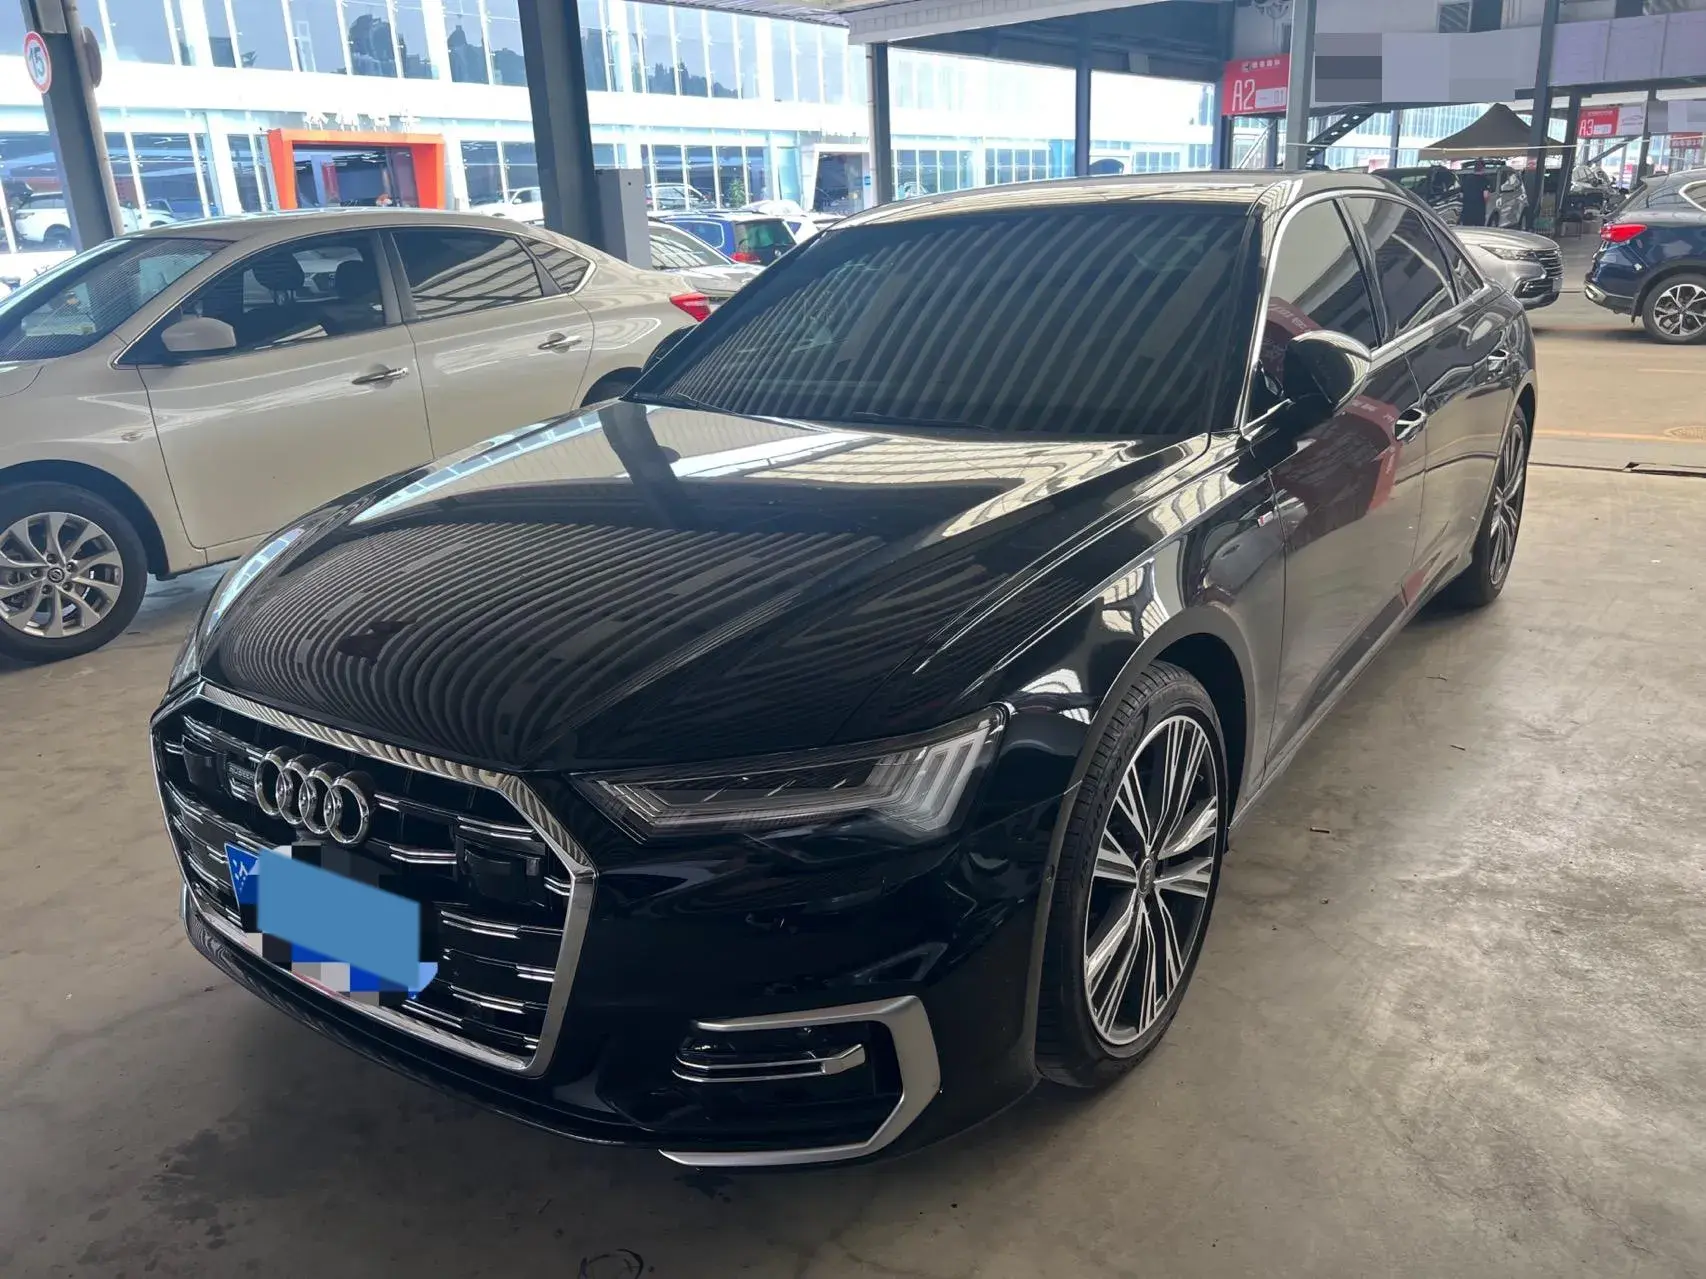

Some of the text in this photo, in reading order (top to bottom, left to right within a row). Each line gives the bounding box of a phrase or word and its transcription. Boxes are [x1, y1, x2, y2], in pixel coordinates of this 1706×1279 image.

[30, 46, 45, 78] 15
[1232, 79, 1255, 111] A2
[1580, 119, 1594, 136] A3
